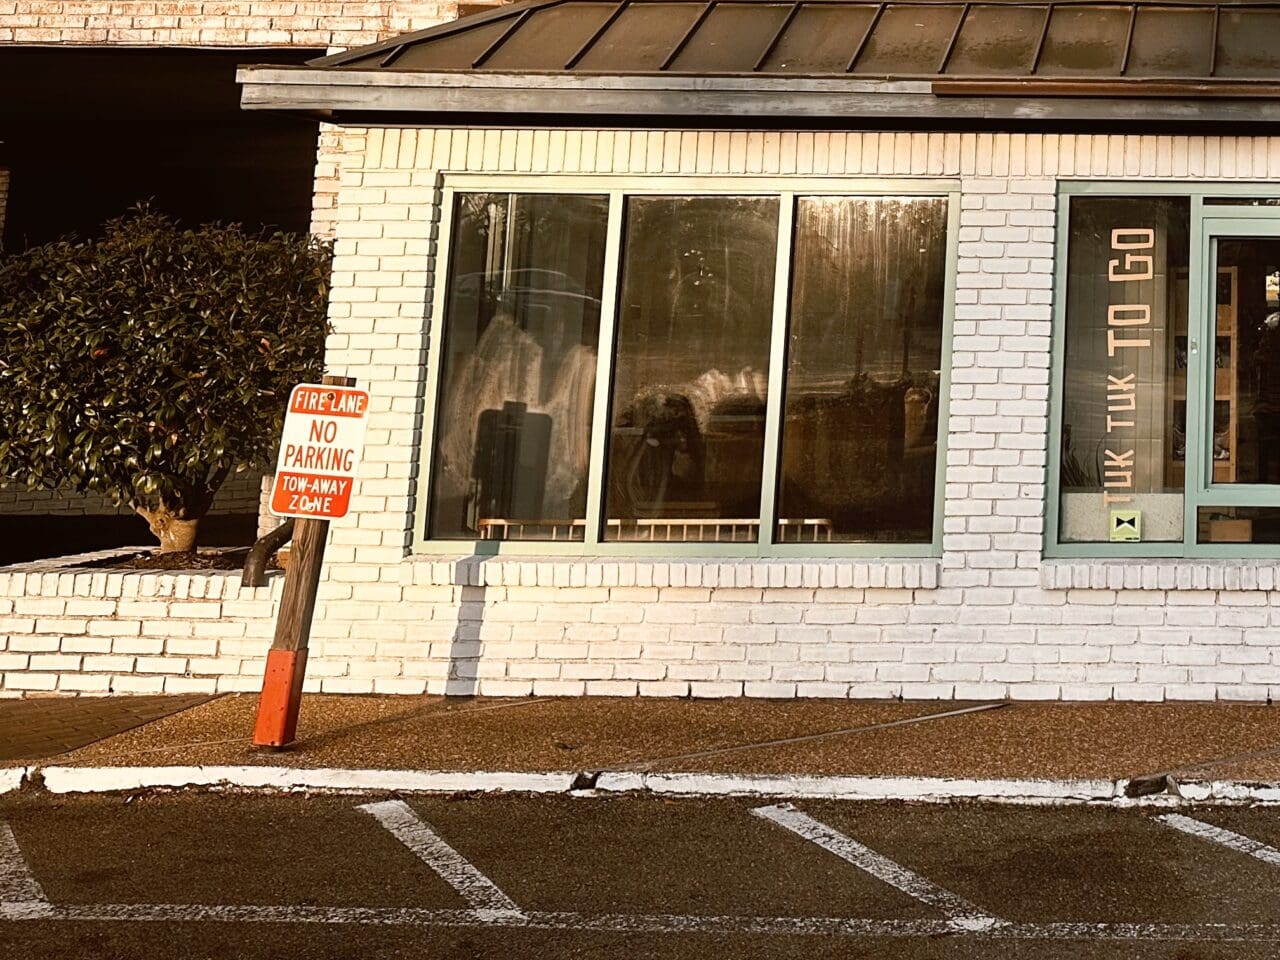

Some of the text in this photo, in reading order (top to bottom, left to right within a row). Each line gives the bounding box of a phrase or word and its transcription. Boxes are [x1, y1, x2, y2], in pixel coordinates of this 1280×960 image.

[1103, 228, 1155, 508] TUK TUK TO GO
[295, 391, 364, 414] FIRE LANE
[309, 420, 337, 443] NO
[285, 445, 354, 471] PARKING
[283, 476, 347, 496] TOW-AWAY
[289, 495, 332, 512] ZONE
